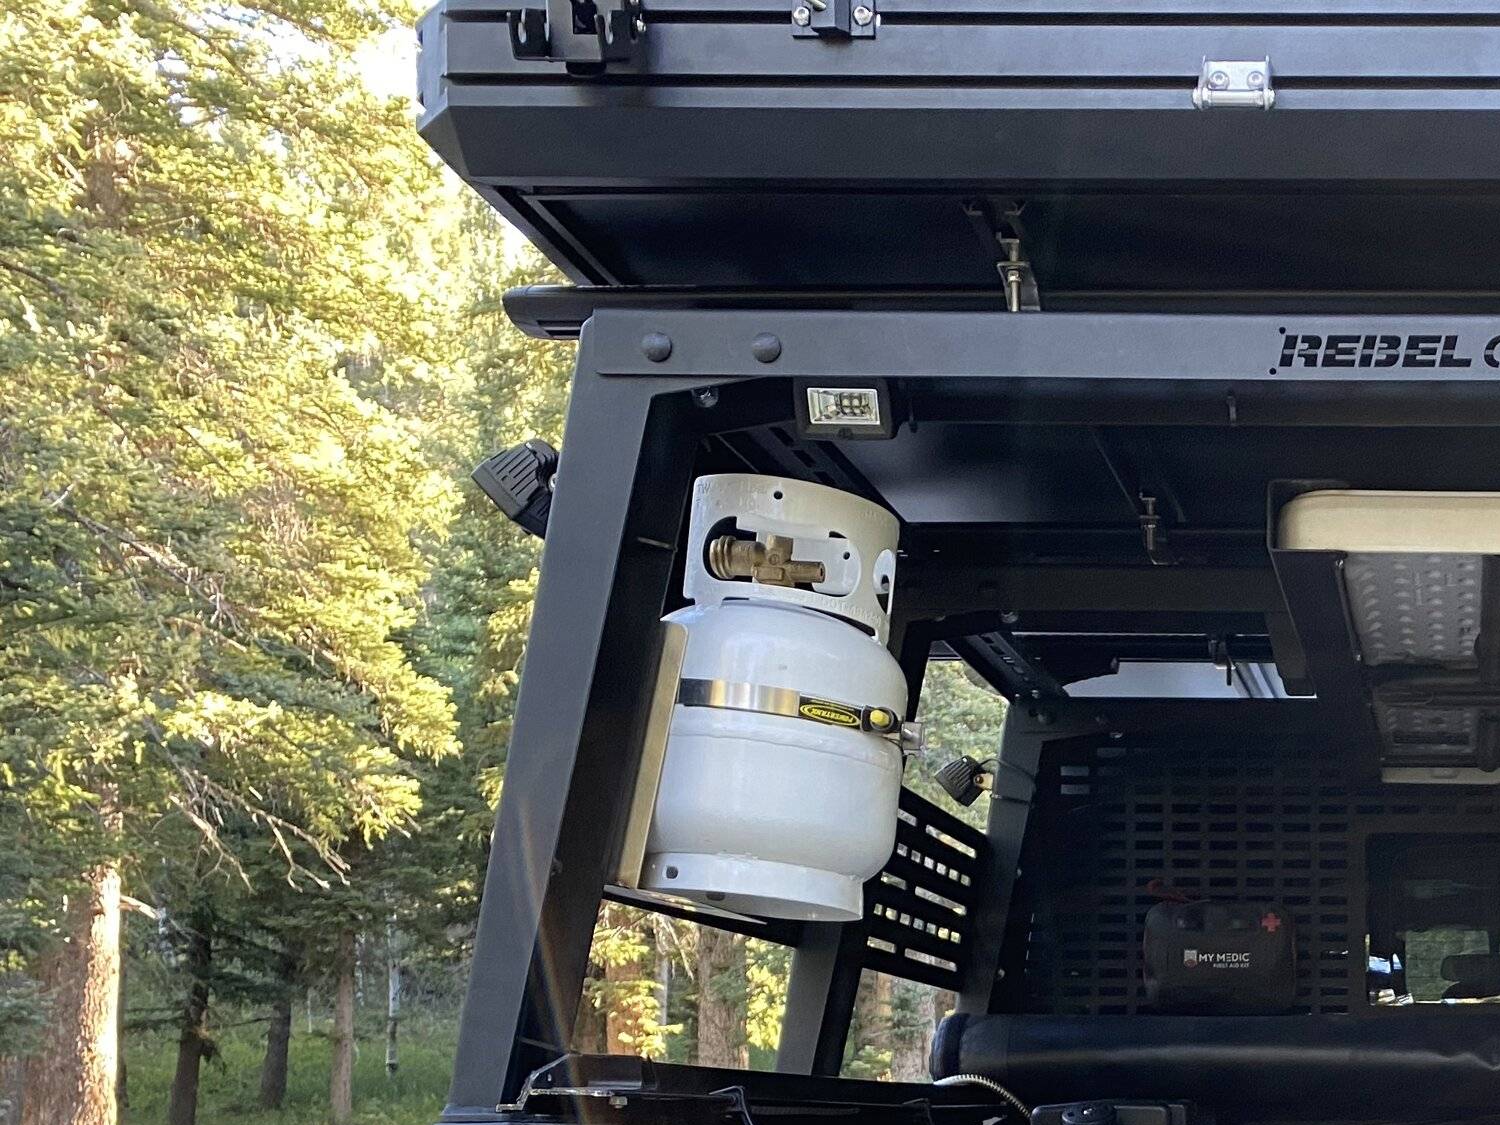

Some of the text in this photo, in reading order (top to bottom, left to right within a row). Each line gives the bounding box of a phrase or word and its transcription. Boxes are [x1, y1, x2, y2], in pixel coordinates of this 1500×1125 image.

[1279, 334, 1472, 368] REBEL
[1198, 952, 1250, 962] MY MEDIC
